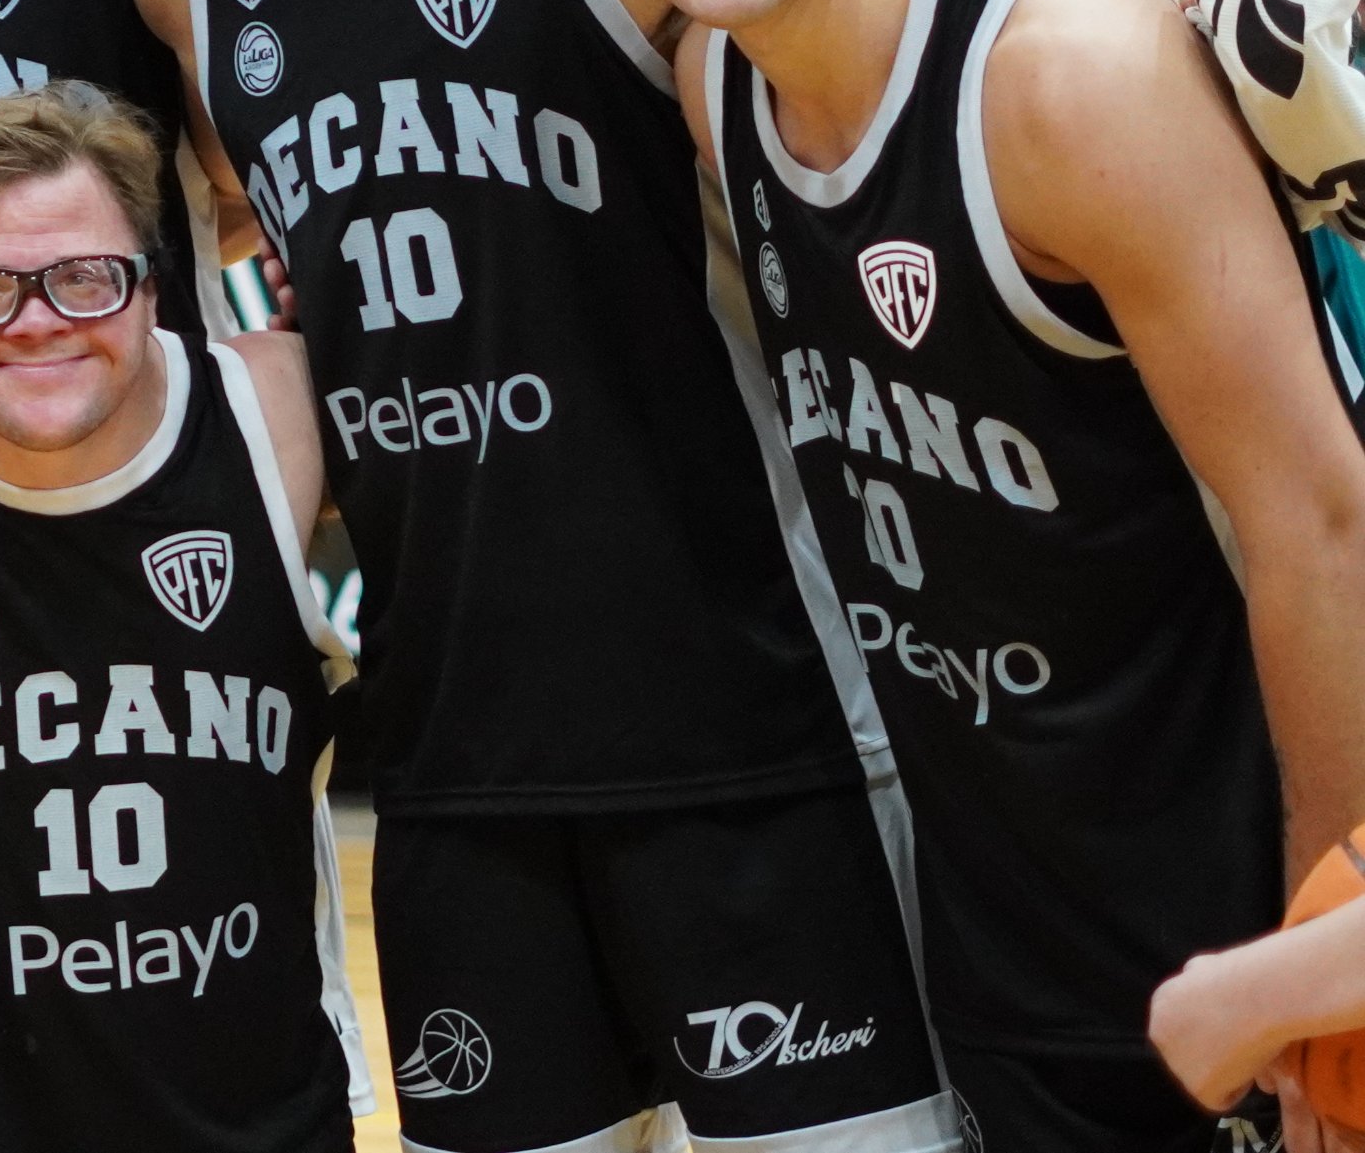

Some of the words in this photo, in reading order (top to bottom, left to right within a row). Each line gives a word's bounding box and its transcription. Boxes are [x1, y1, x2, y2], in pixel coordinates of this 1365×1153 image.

[246, 78, 603, 270] DECANO
[340, 207, 463, 331] 10
[325, 373, 552, 464] Pelayo
[771, 347, 1059, 512] ECANO
[33, 782, 168, 896] 10
[8, 902, 259, 998] Pelayo
